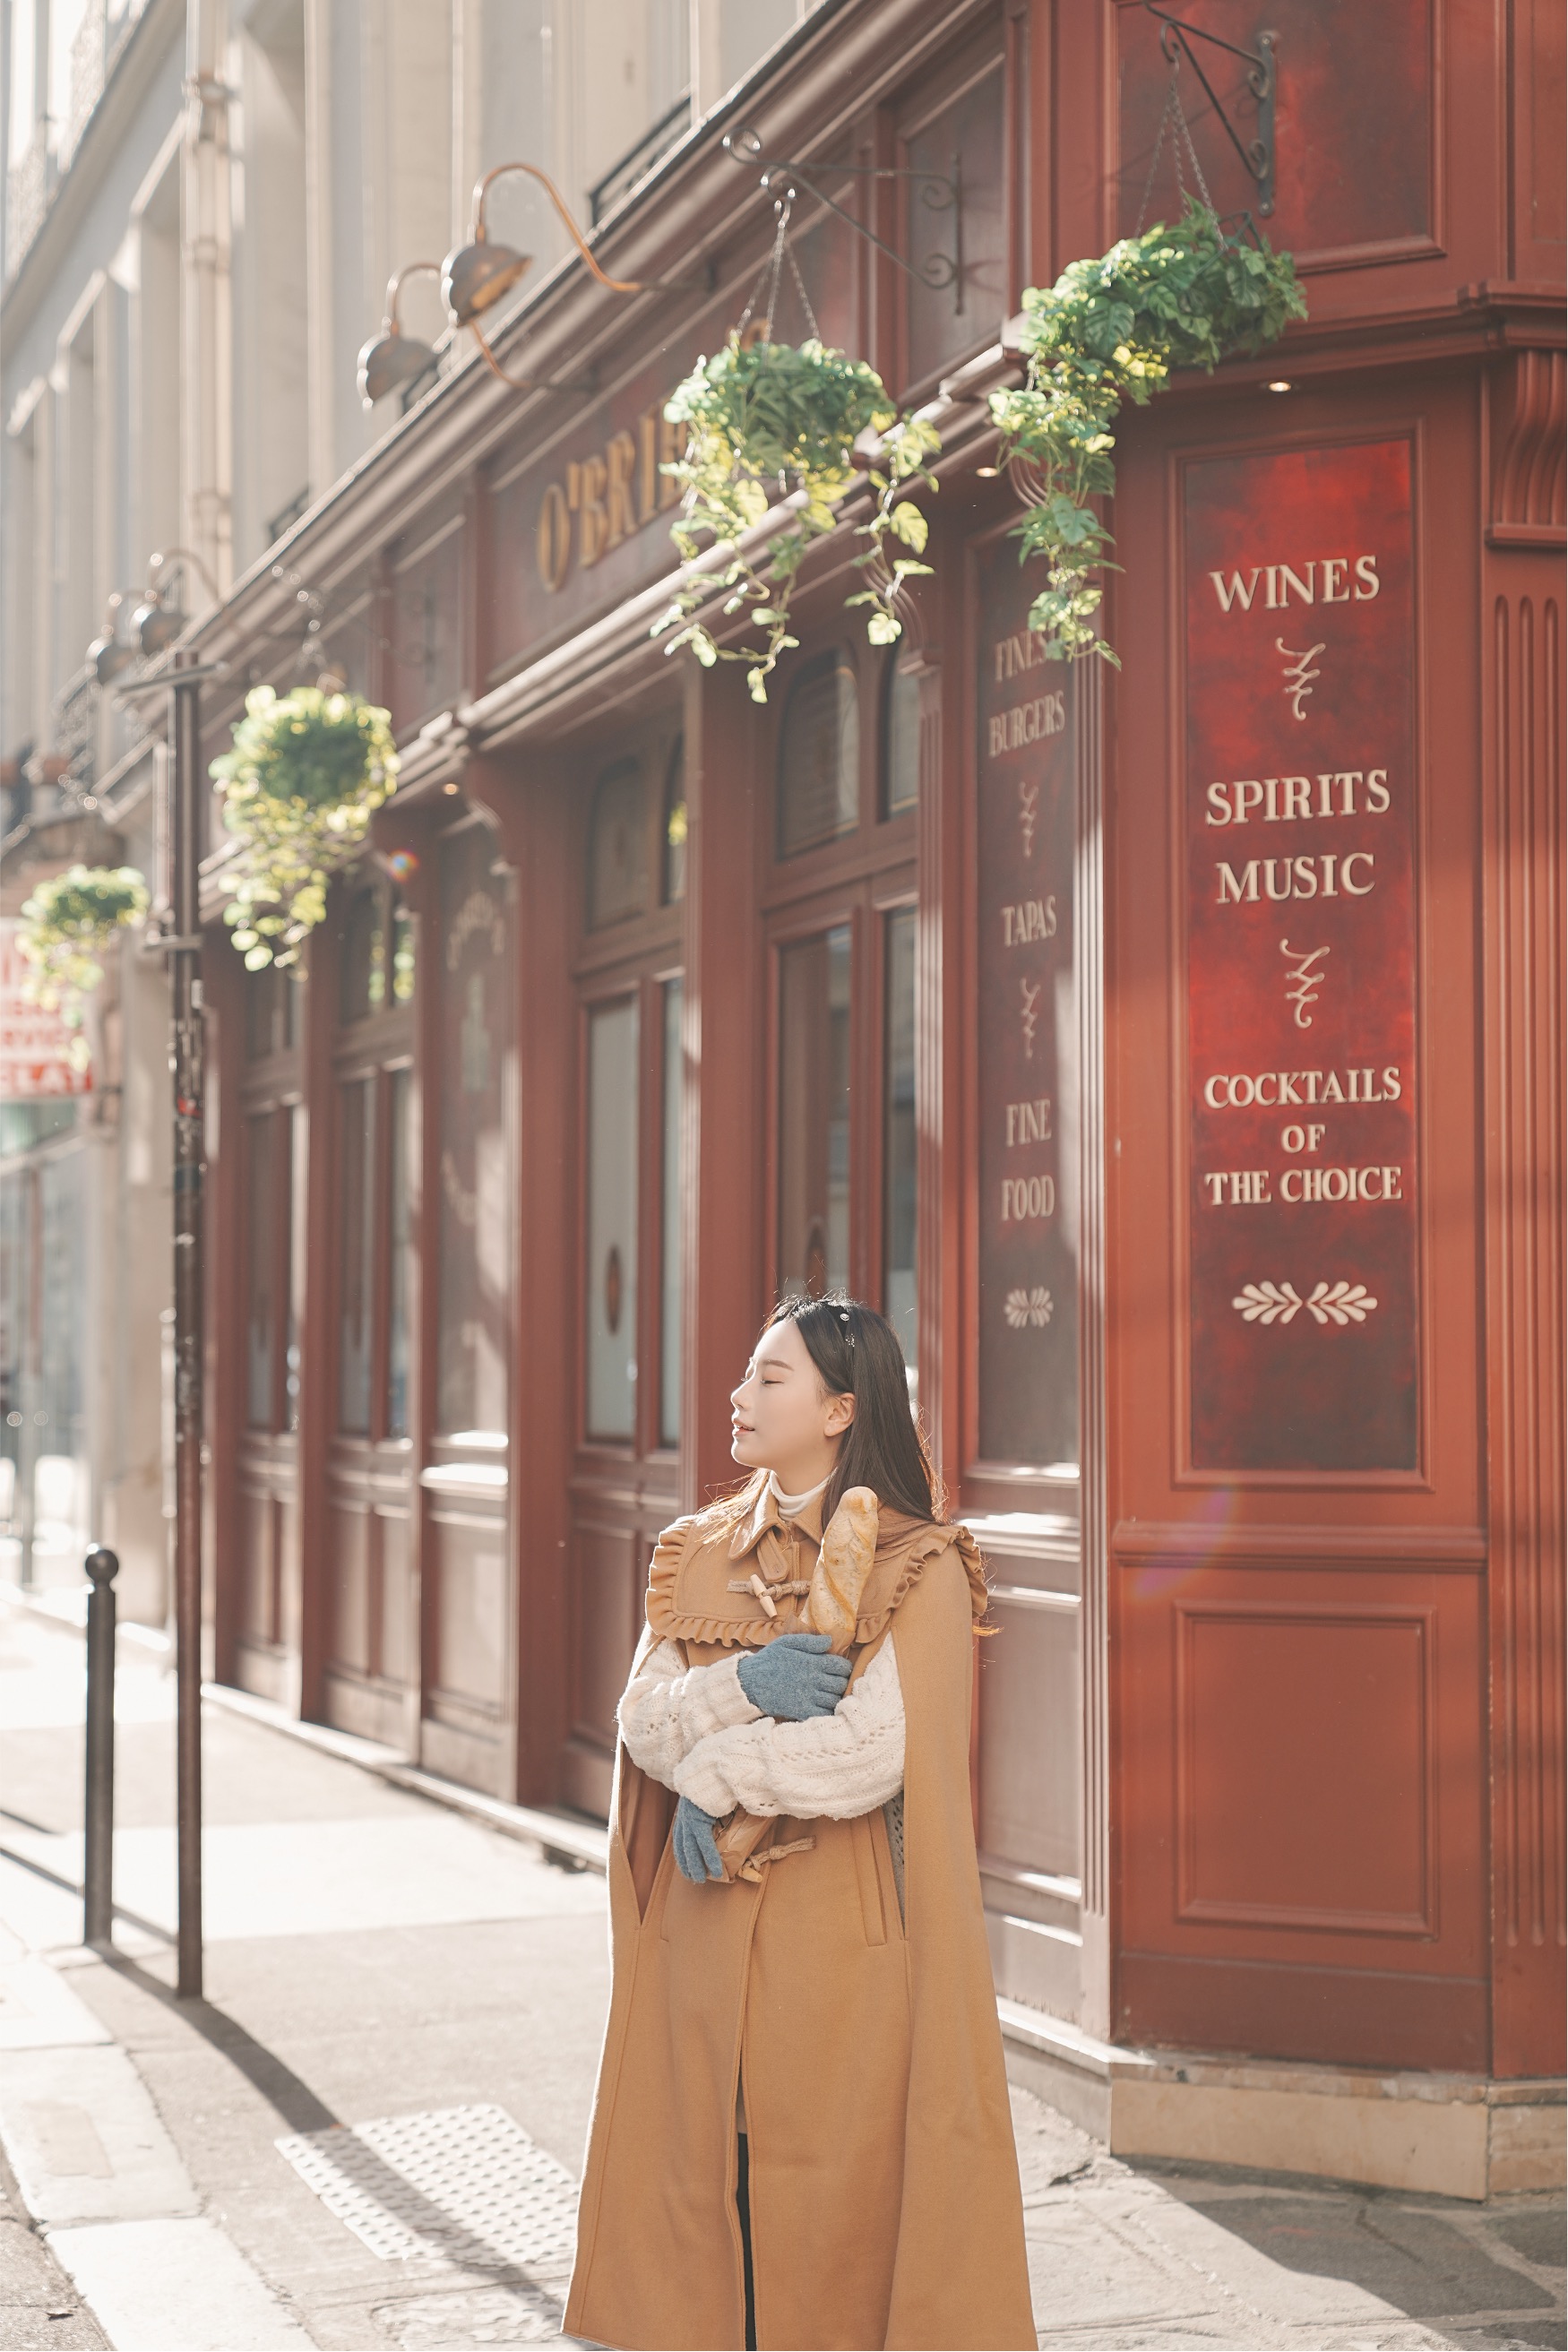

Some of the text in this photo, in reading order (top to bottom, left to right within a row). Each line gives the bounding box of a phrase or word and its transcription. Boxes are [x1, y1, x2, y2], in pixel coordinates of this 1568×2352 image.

[1209, 555, 1381, 613] WINES
[989, 690, 1065, 758] BURGERS
[1205, 768, 1391, 826] SPIRITS
[1215, 852, 1376, 904] MUSIC
[1001, 894, 1057, 947] TAPAS
[1204, 1066, 1402, 1109] COCKTAILS
[1006, 1098, 1053, 1147] FINE
[1281, 1124, 1326, 1154] OF
[1001, 1174, 1055, 1222] FOOD
[1205, 1167, 1402, 1206] THE CHOICE
